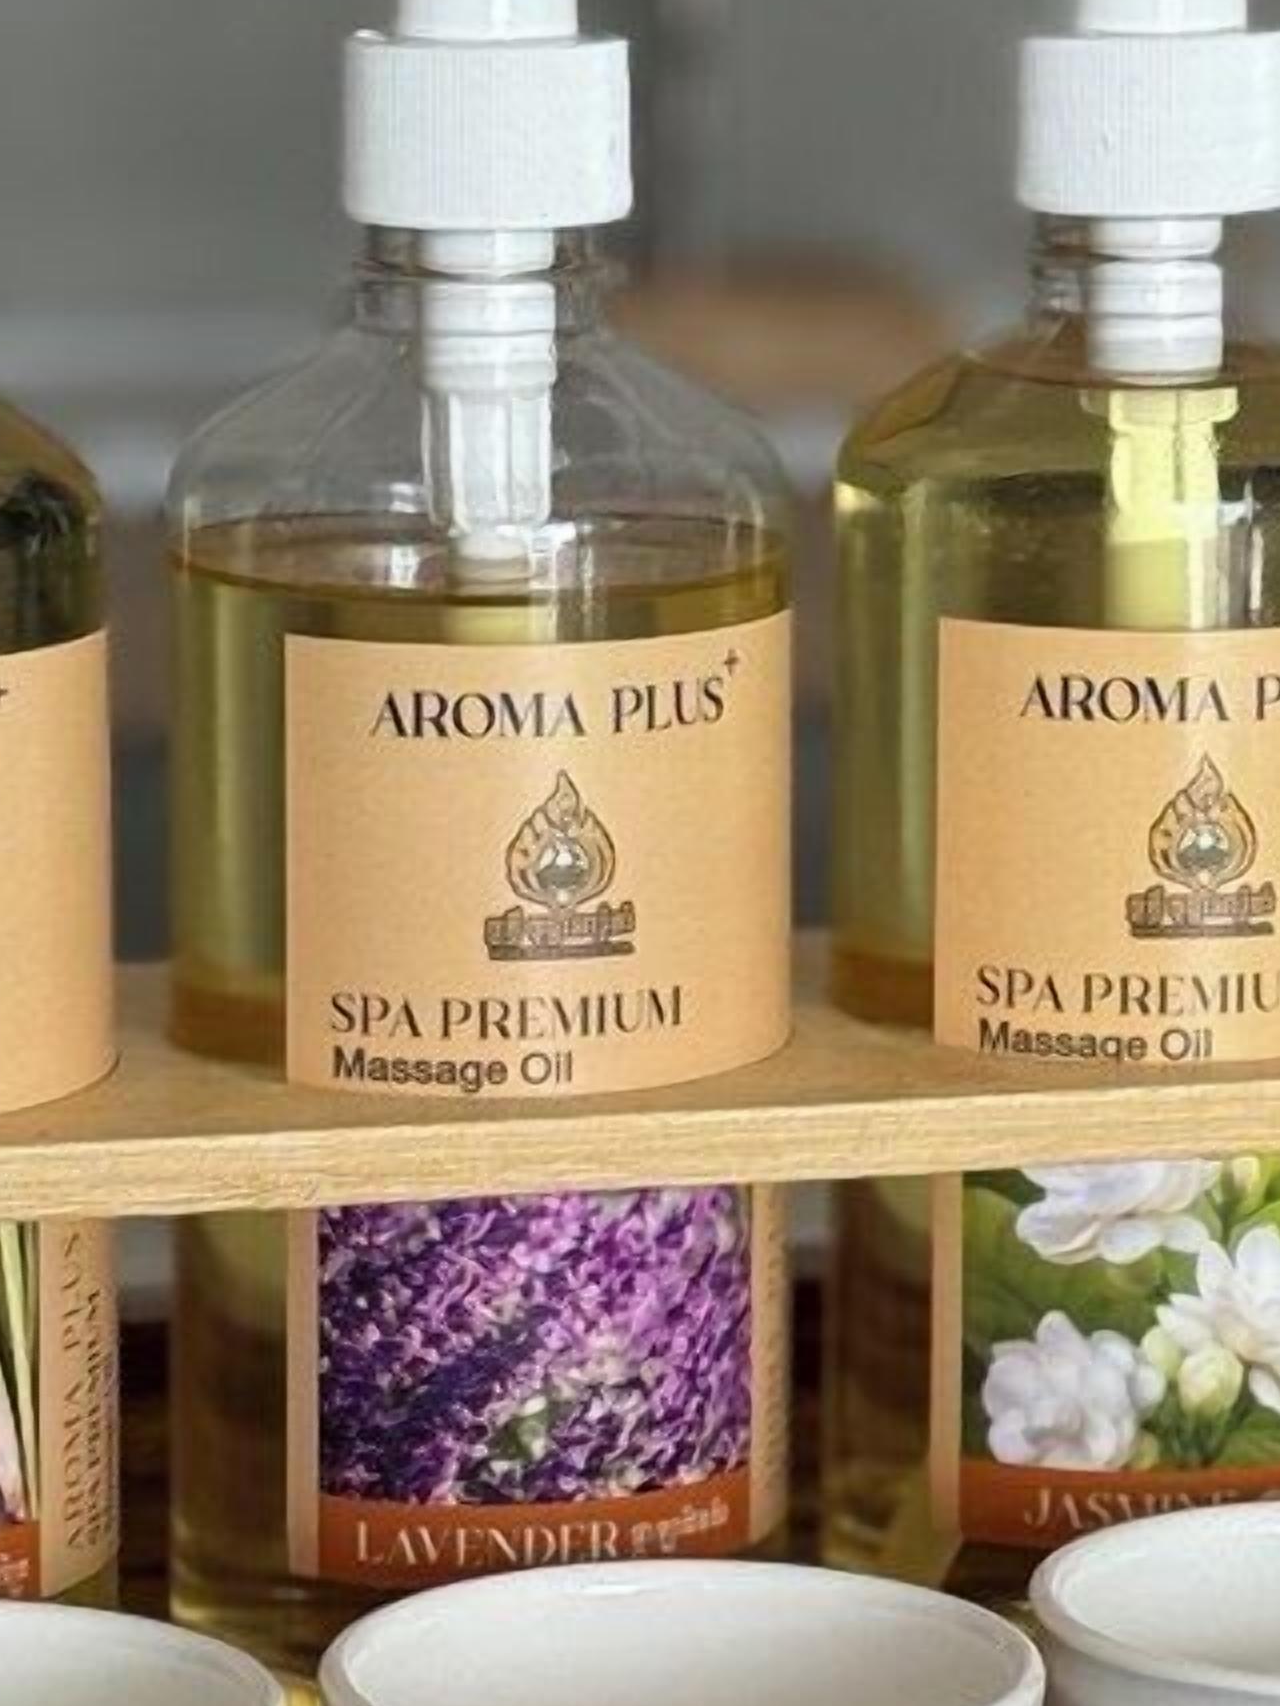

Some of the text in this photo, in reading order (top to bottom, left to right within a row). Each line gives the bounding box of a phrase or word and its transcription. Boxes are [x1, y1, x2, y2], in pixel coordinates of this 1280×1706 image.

[371, 689, 587, 739] AROMA
[1019, 673, 1230, 722] AROMA
[975, 964, 1063, 1012] SPA
[329, 986, 684, 1041] SPA PREMIUM
[978, 1017, 1213, 1062] Massage Oil
[331, 1045, 573, 1093] Massage Oil
[356, 1520, 619, 1566] LAVENDER
